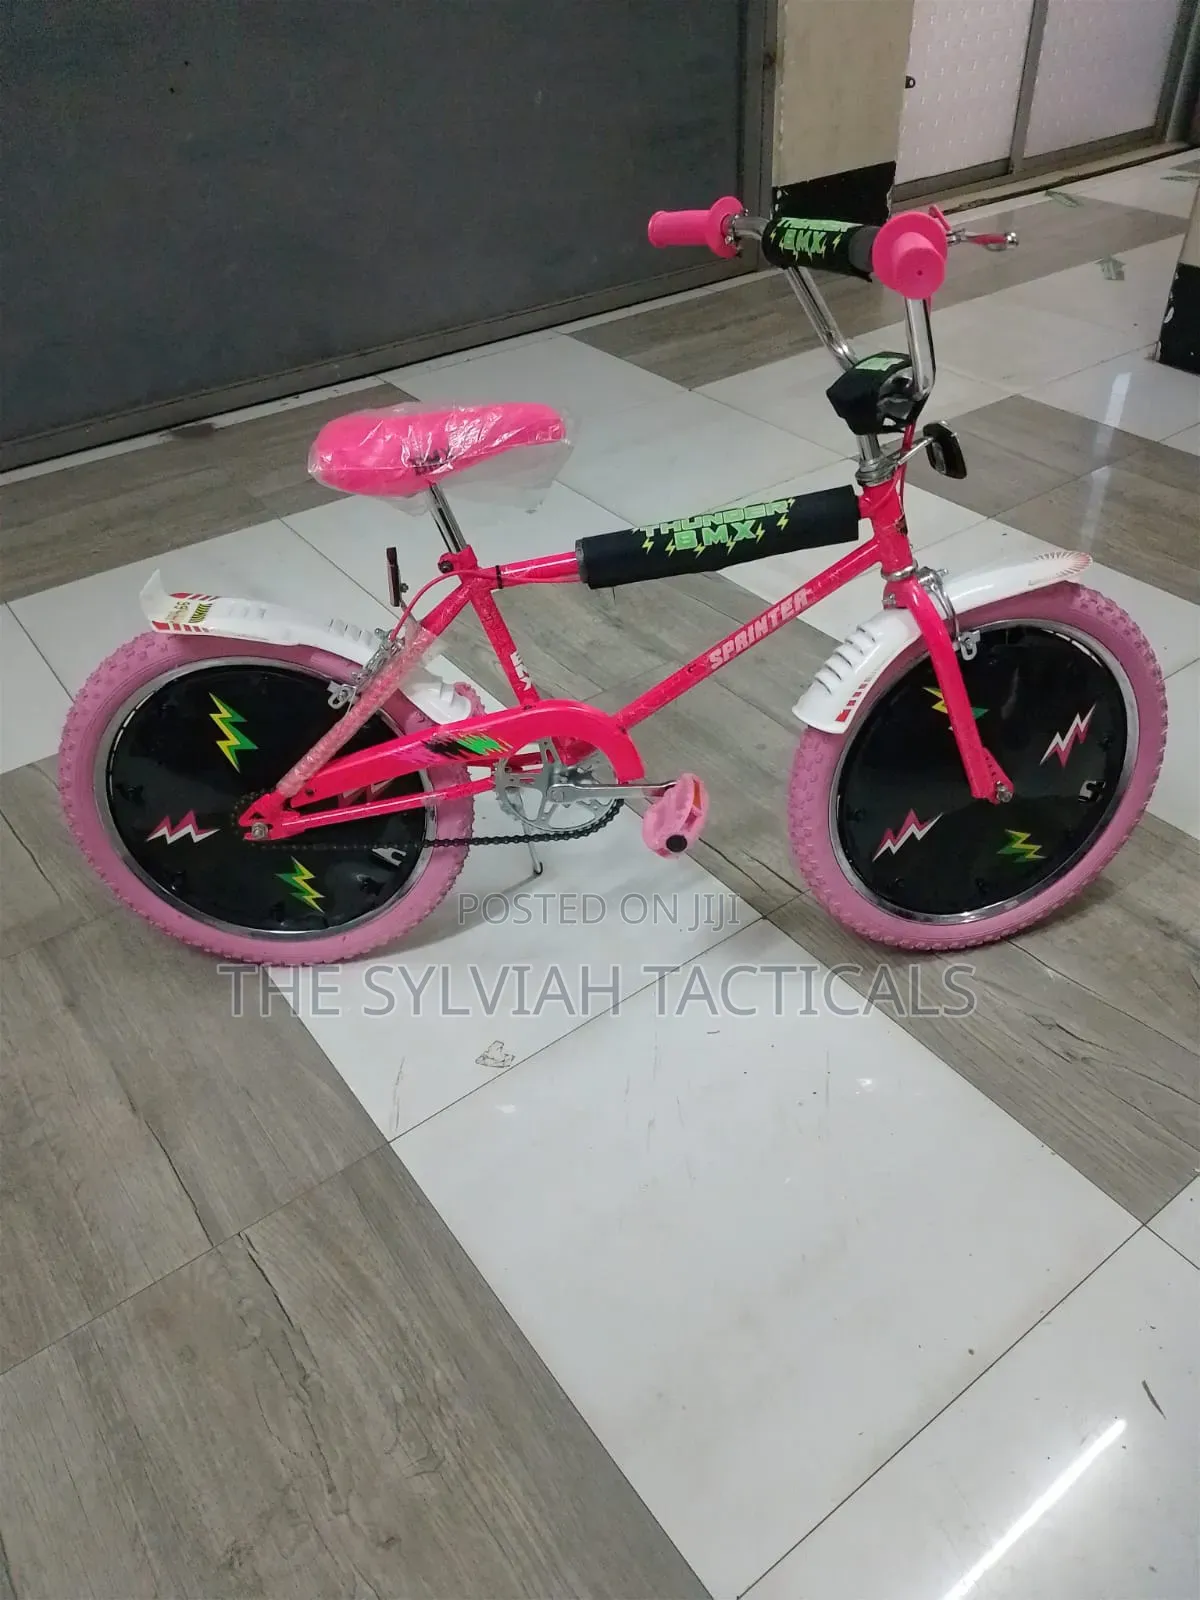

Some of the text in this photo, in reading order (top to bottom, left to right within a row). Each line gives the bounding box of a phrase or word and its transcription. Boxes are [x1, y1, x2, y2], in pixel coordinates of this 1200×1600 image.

[783, 228, 827, 255] BMX
[638, 500, 790, 537] THUNDER
[674, 519, 756, 551] BMX
[707, 587, 806, 669] SPRINTER
